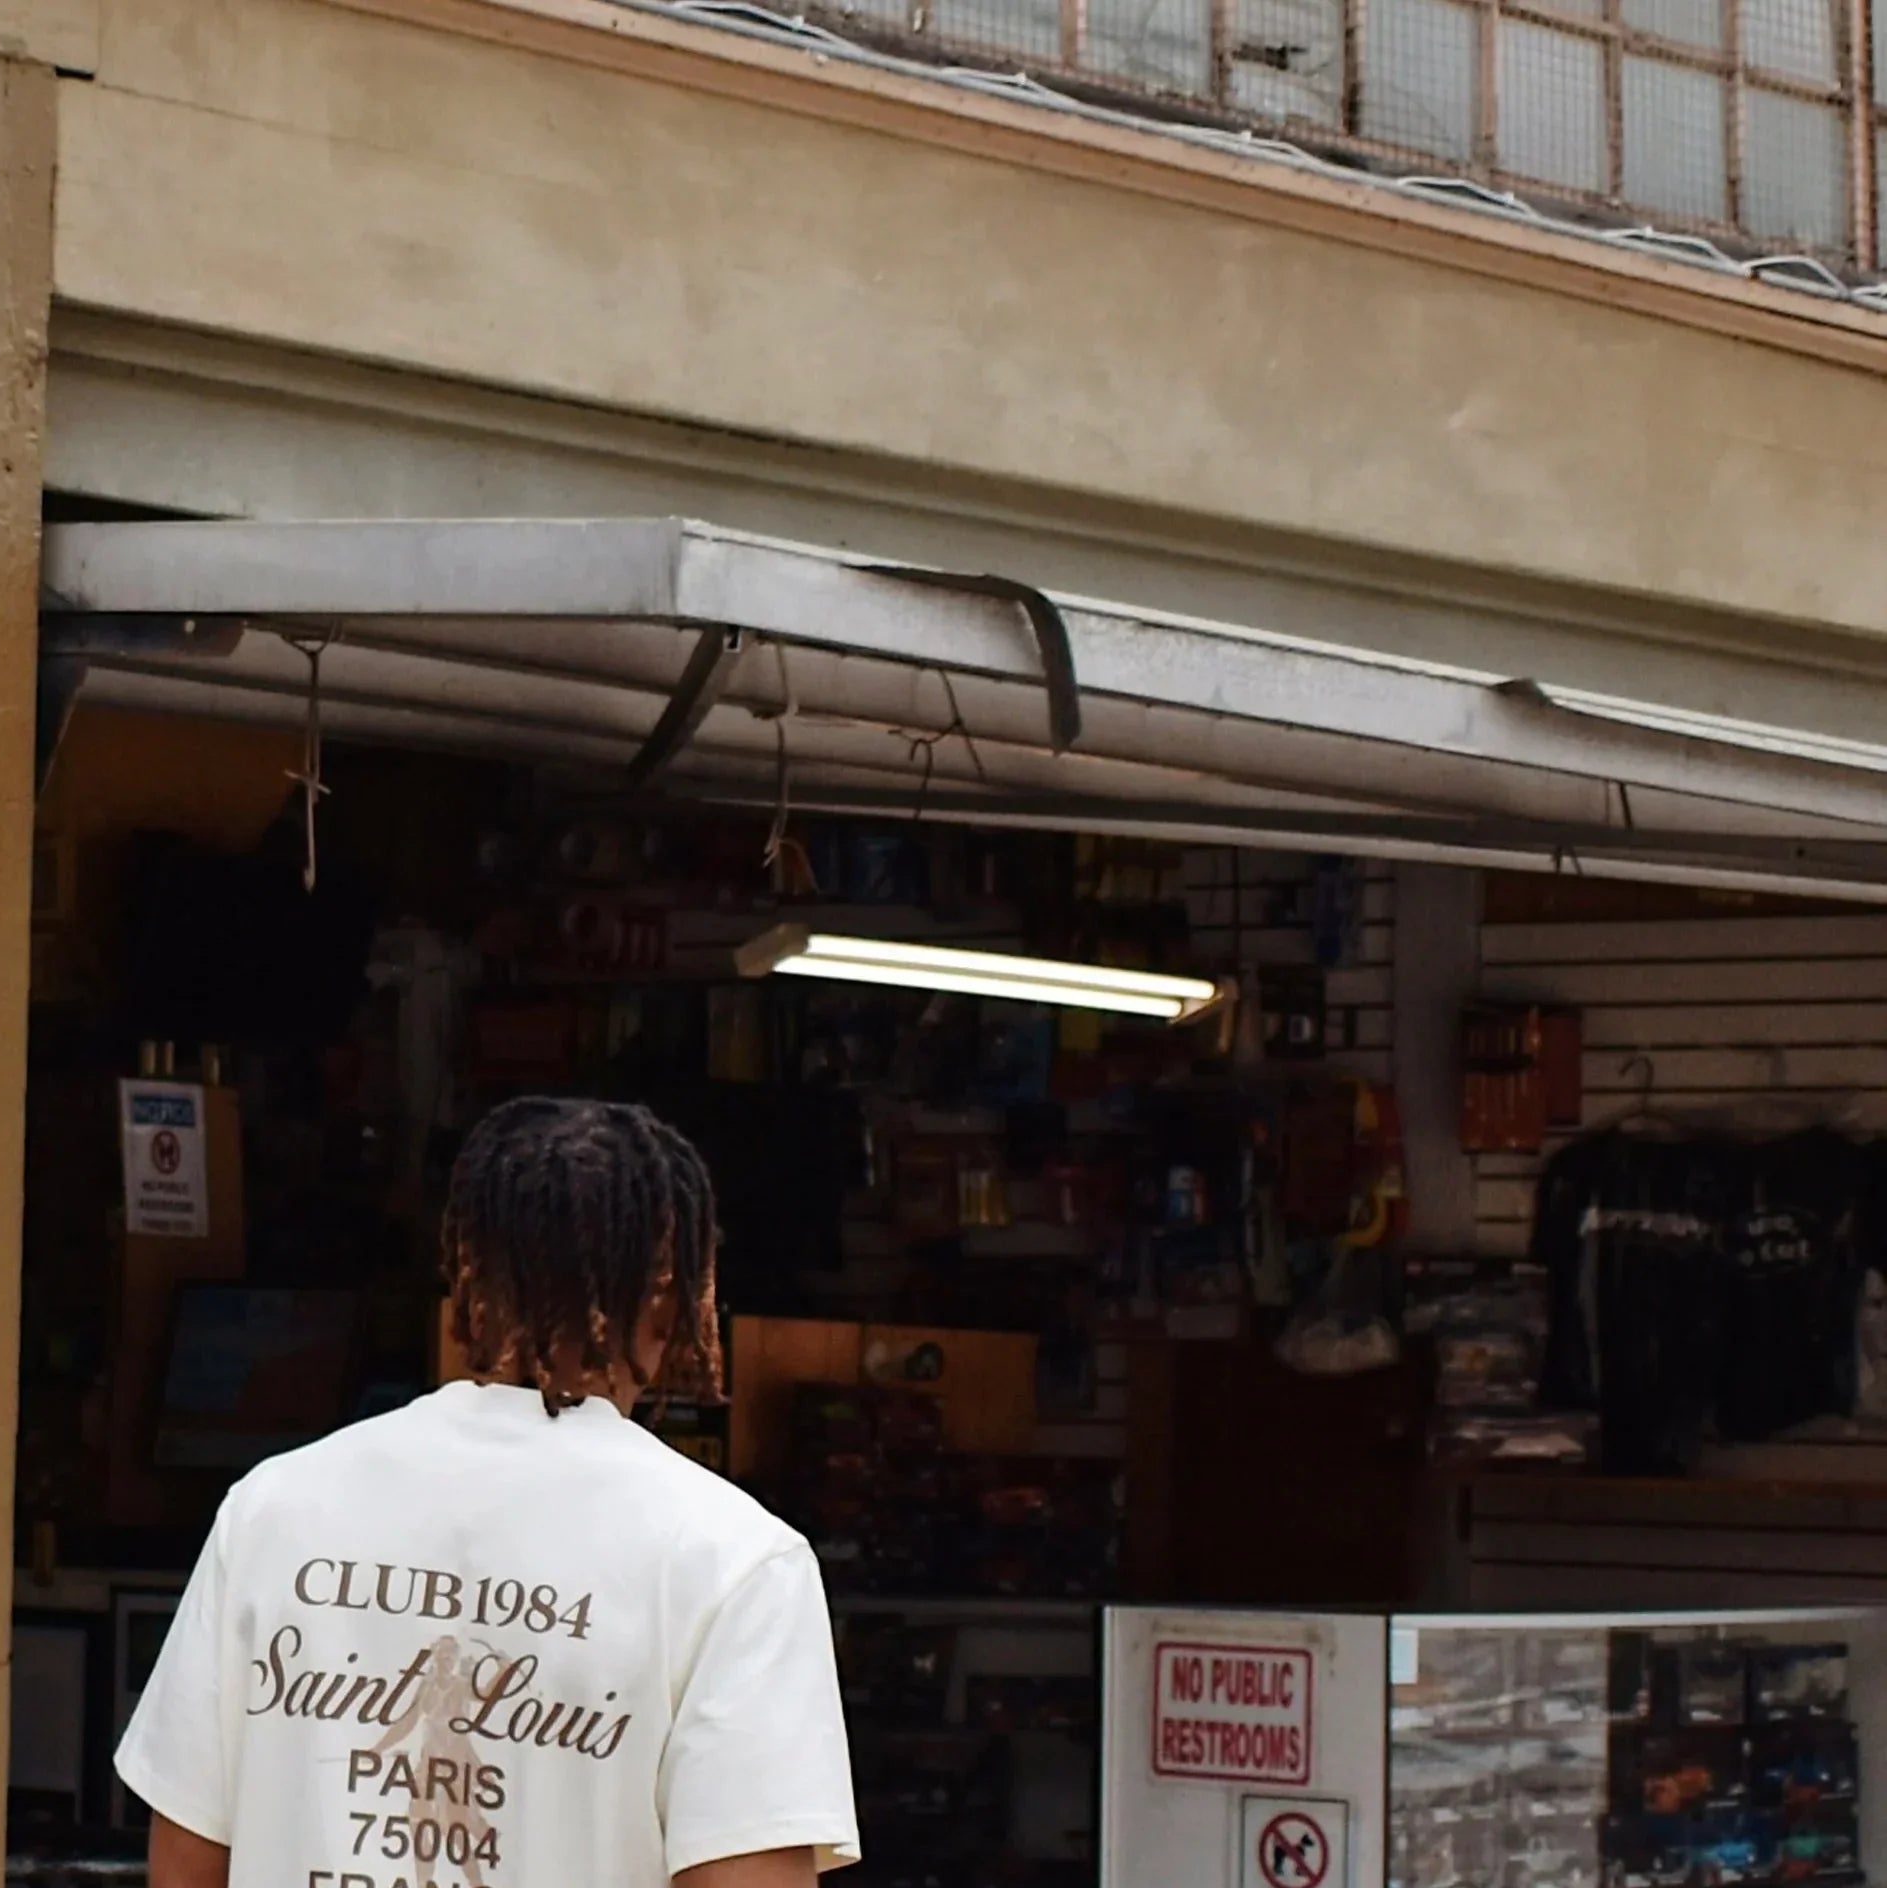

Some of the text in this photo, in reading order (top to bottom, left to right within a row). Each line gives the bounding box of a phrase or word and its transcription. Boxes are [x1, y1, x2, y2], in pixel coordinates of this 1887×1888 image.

[246, 1625, 632, 1760] Saint Louis
[1171, 1656, 1294, 1708] NO PUBLIC
[1162, 1718, 1300, 1772] RESTROOMS
[347, 1749, 506, 1810] PARIS
[349, 1812, 502, 1870] 75004
